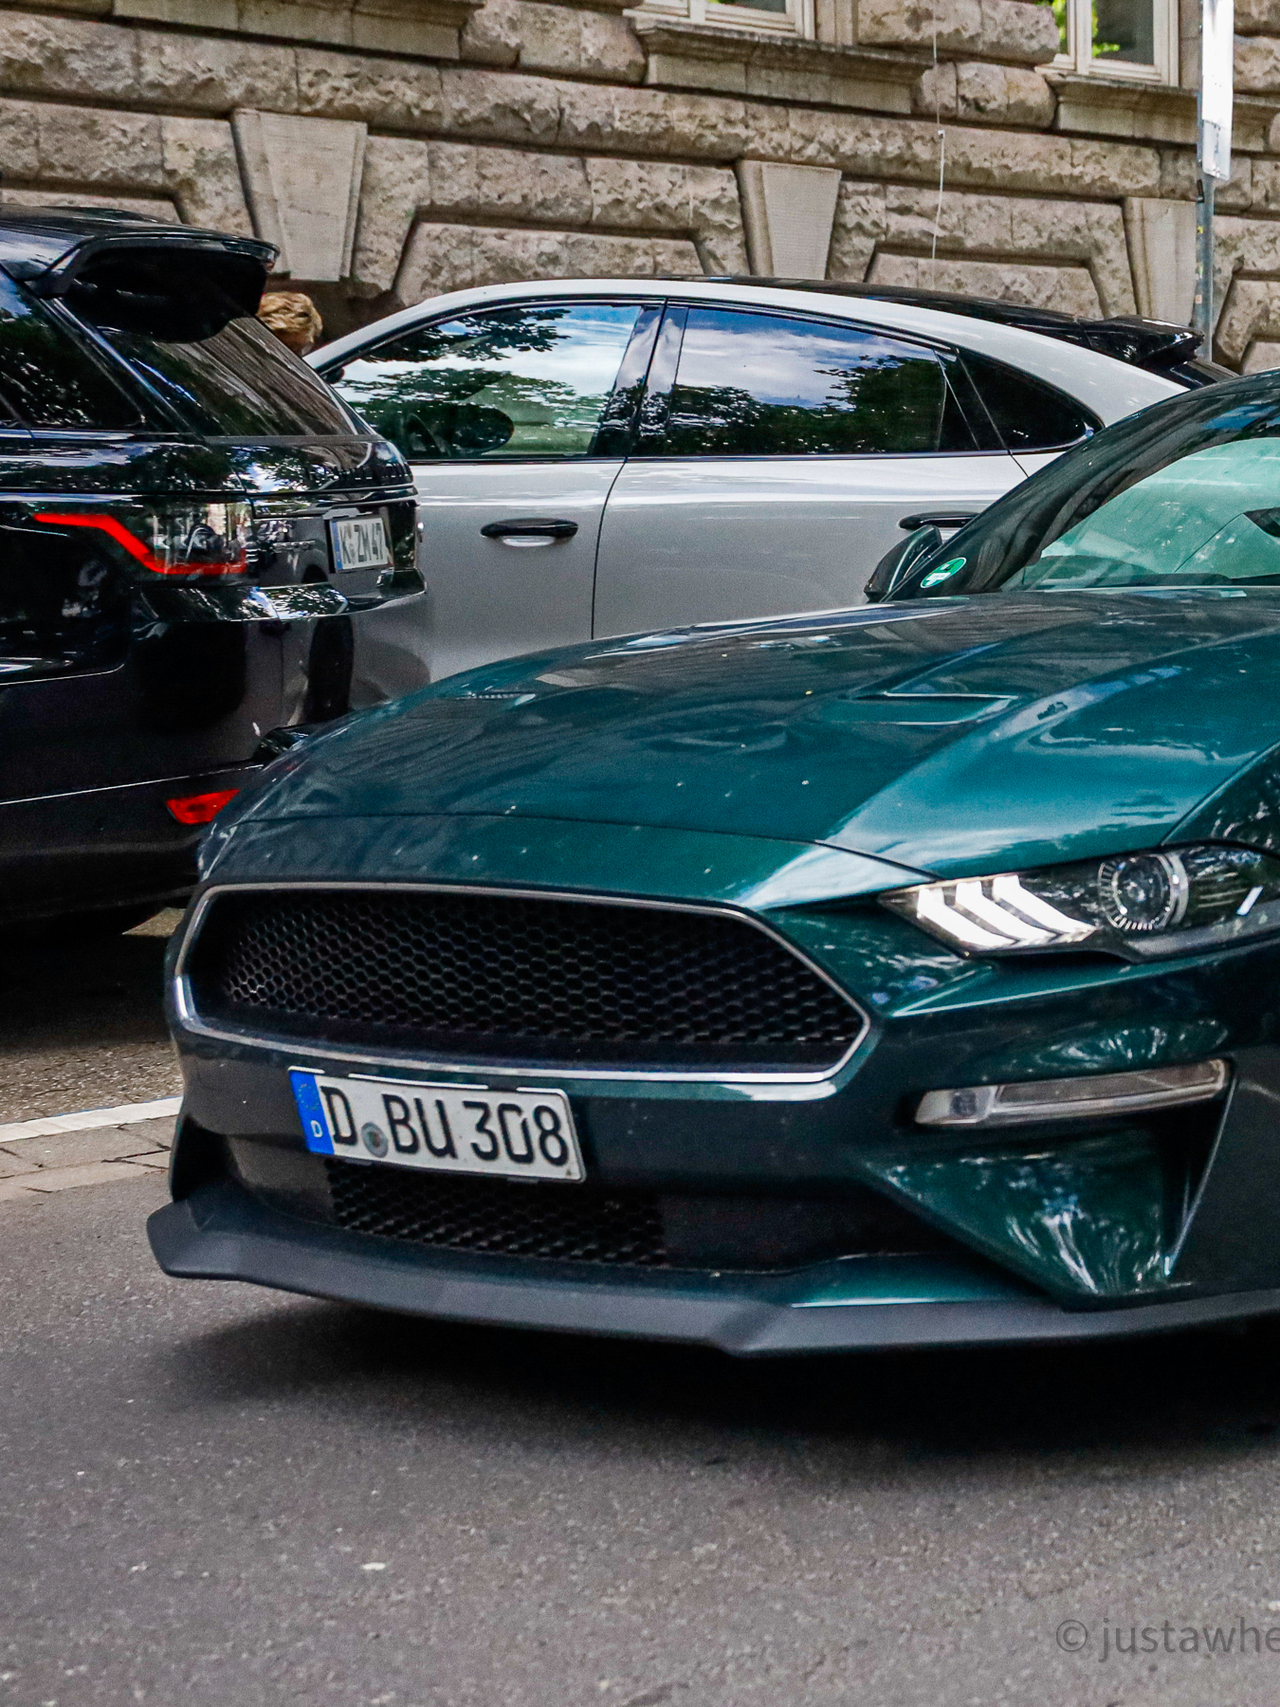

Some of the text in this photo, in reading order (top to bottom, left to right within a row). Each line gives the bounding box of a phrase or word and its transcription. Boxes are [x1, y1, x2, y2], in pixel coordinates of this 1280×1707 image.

[310, 1119, 324, 1138] D
[321, 1085, 570, 1167] D BU 308
